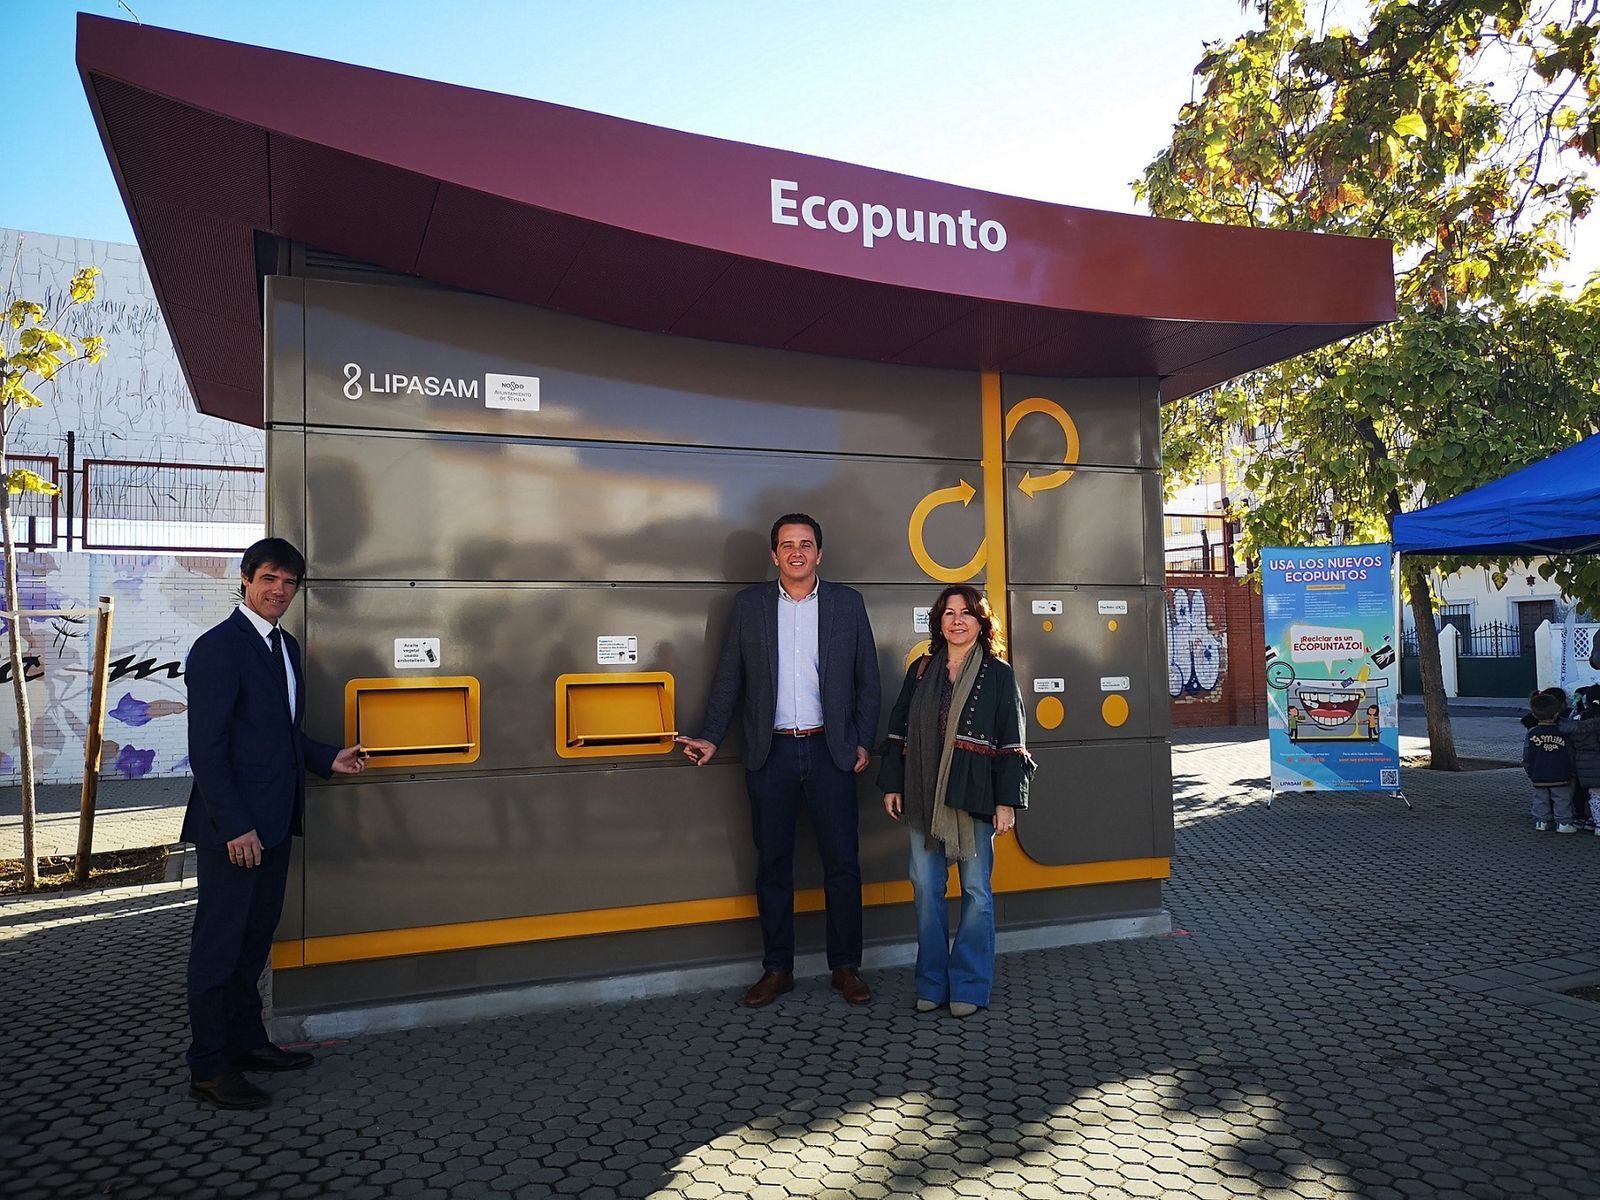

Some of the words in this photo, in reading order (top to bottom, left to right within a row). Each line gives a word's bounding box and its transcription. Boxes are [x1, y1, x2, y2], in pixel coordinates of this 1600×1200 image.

[770, 178, 1008, 252] Ecopunto
[369, 373, 479, 399] LIPASAM
[1270, 559, 1296, 570] USA
[1299, 558, 1324, 570] LOS
[1328, 556, 1382, 569] NUEVOS
[1285, 569, 1367, 583] ECOPUNTOS
[1293, 642, 1363, 652] ECOPUNTAZO!
